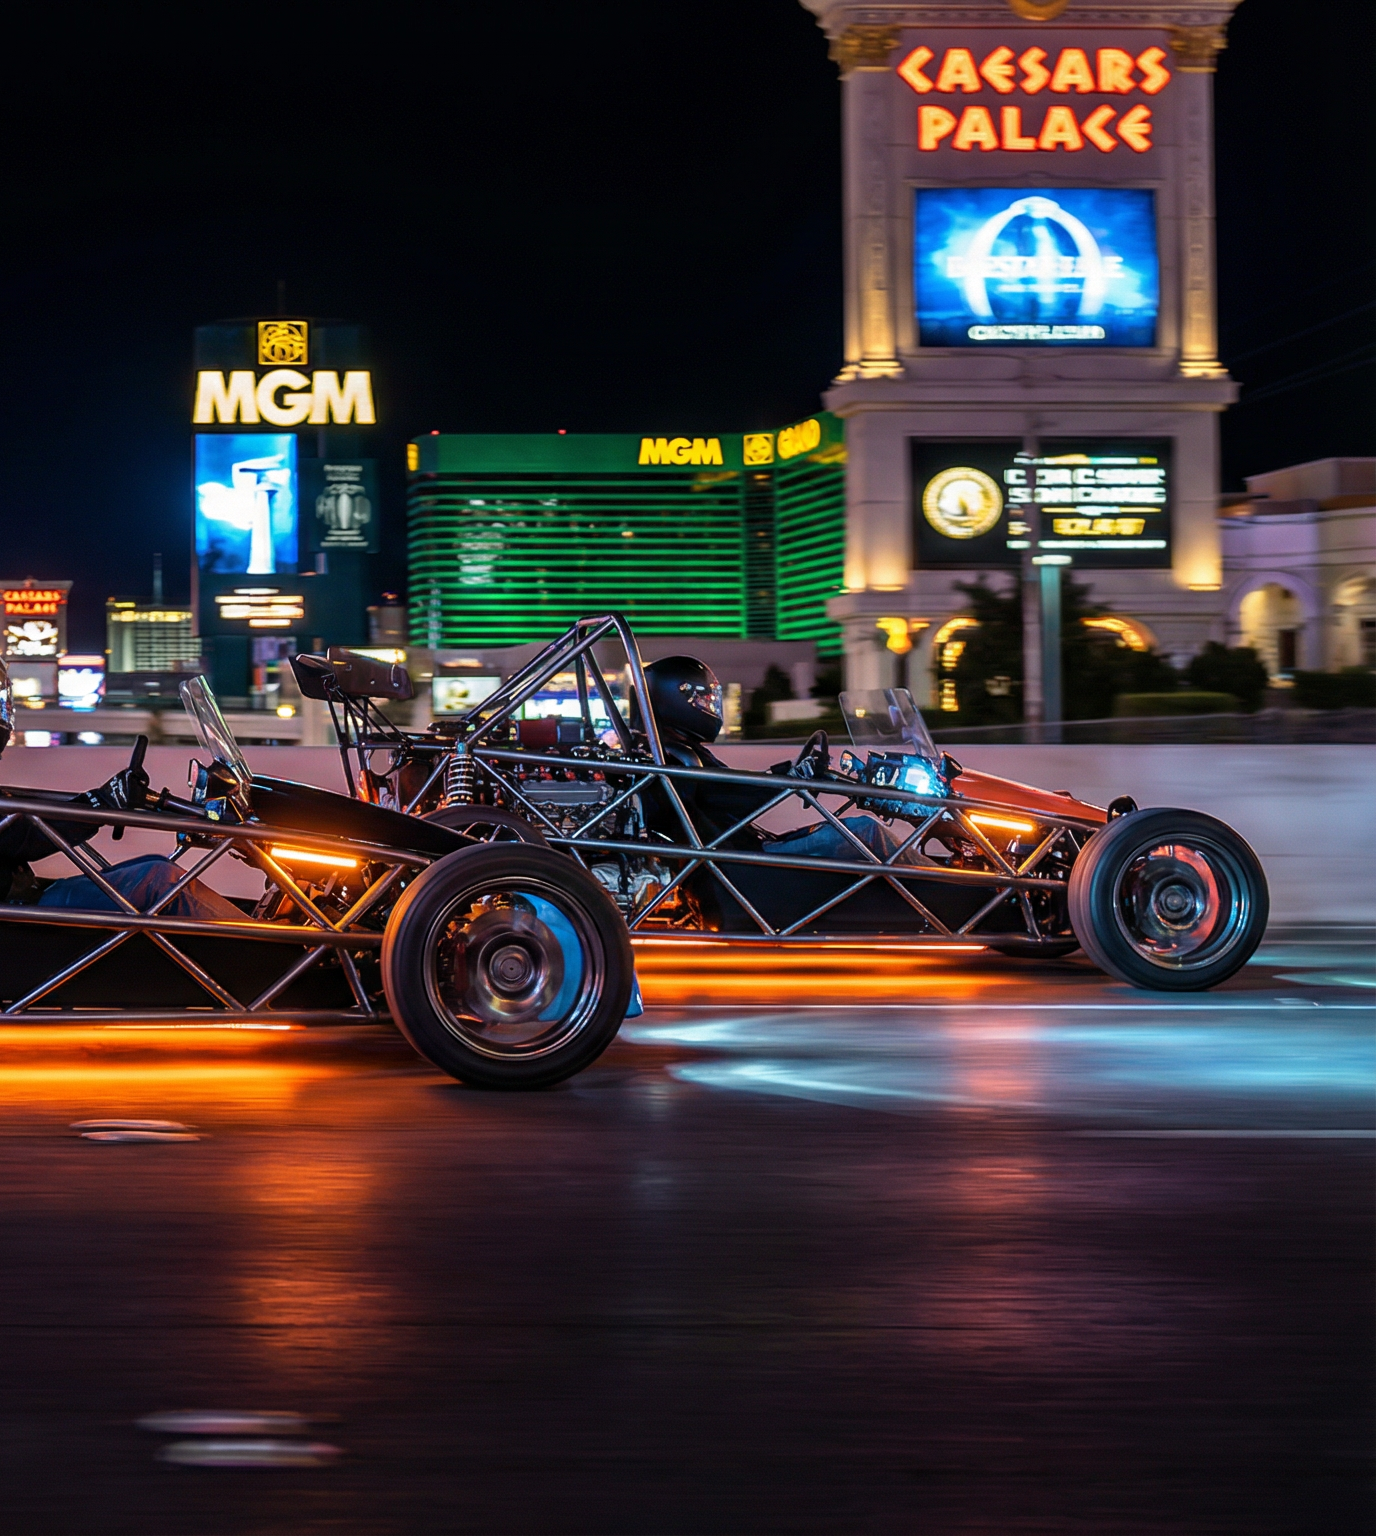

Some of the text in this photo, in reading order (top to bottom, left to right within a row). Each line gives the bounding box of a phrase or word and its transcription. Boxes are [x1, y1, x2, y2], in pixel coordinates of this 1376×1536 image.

[897, 45, 1172, 96] CAESARS
[916, 104, 1154, 154] PALACE
[192, 368, 377, 427] MGM
[638, 437, 724, 466] MGM
